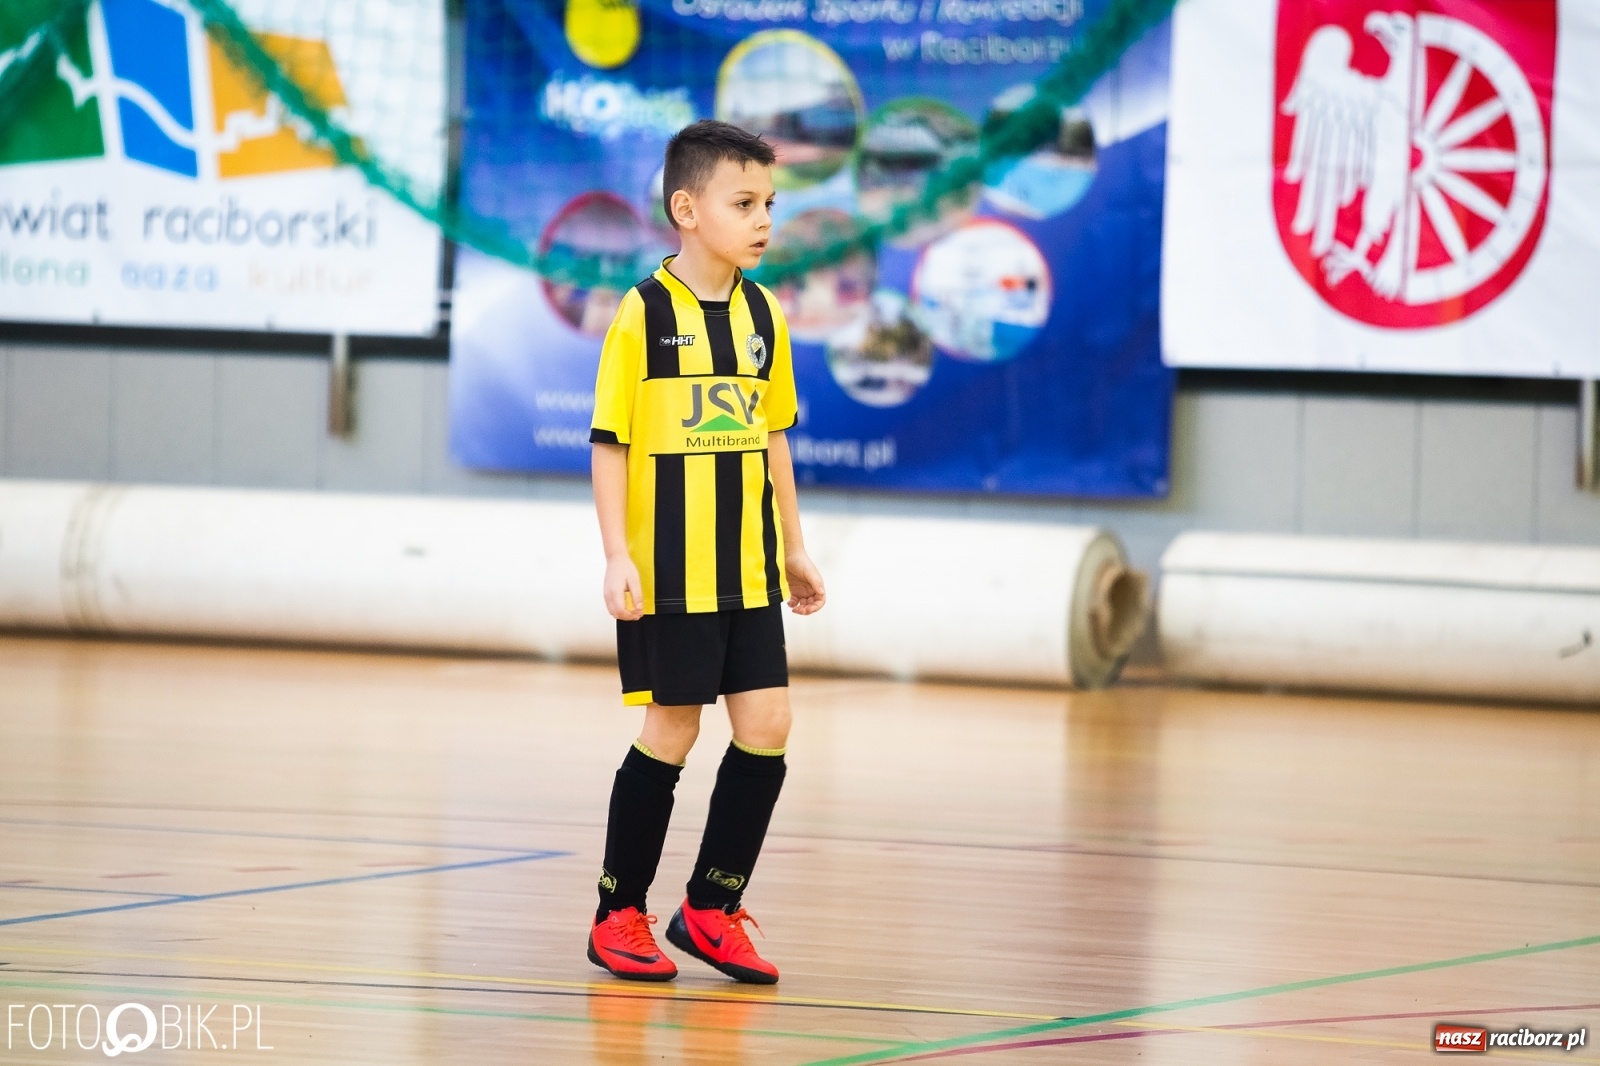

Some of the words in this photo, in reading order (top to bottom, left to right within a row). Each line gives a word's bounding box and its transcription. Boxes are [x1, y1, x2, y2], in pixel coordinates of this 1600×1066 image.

[0, 187, 110, 242] wiat
[143, 194, 378, 248] raciborski
[0, 251, 91, 287] lona
[671, 336, 695, 346] HHT
[681, 383, 759, 428] JSV
[686, 436, 760, 448] Multibrand
